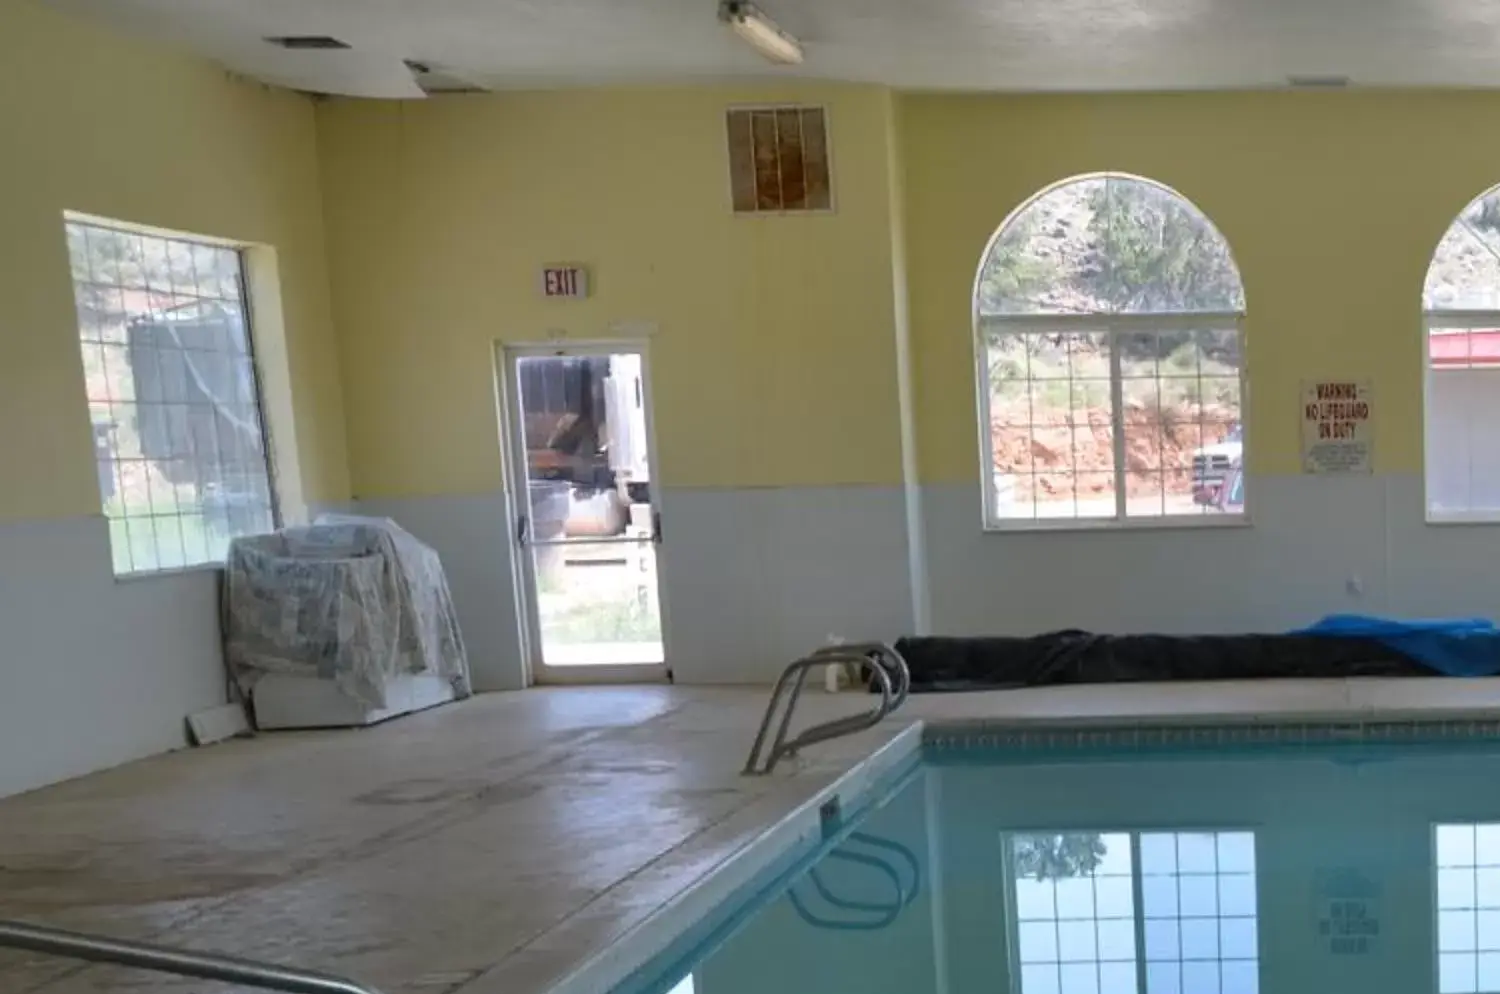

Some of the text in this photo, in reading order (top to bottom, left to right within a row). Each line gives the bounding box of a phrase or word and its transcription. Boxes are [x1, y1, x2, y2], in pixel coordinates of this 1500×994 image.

[544, 268, 577, 296] EXIT
[1316, 383, 1356, 400] WARNING
[1306, 402, 1368, 420] NO LIFEGUARD
[1319, 421, 1356, 440] ON DUTY
